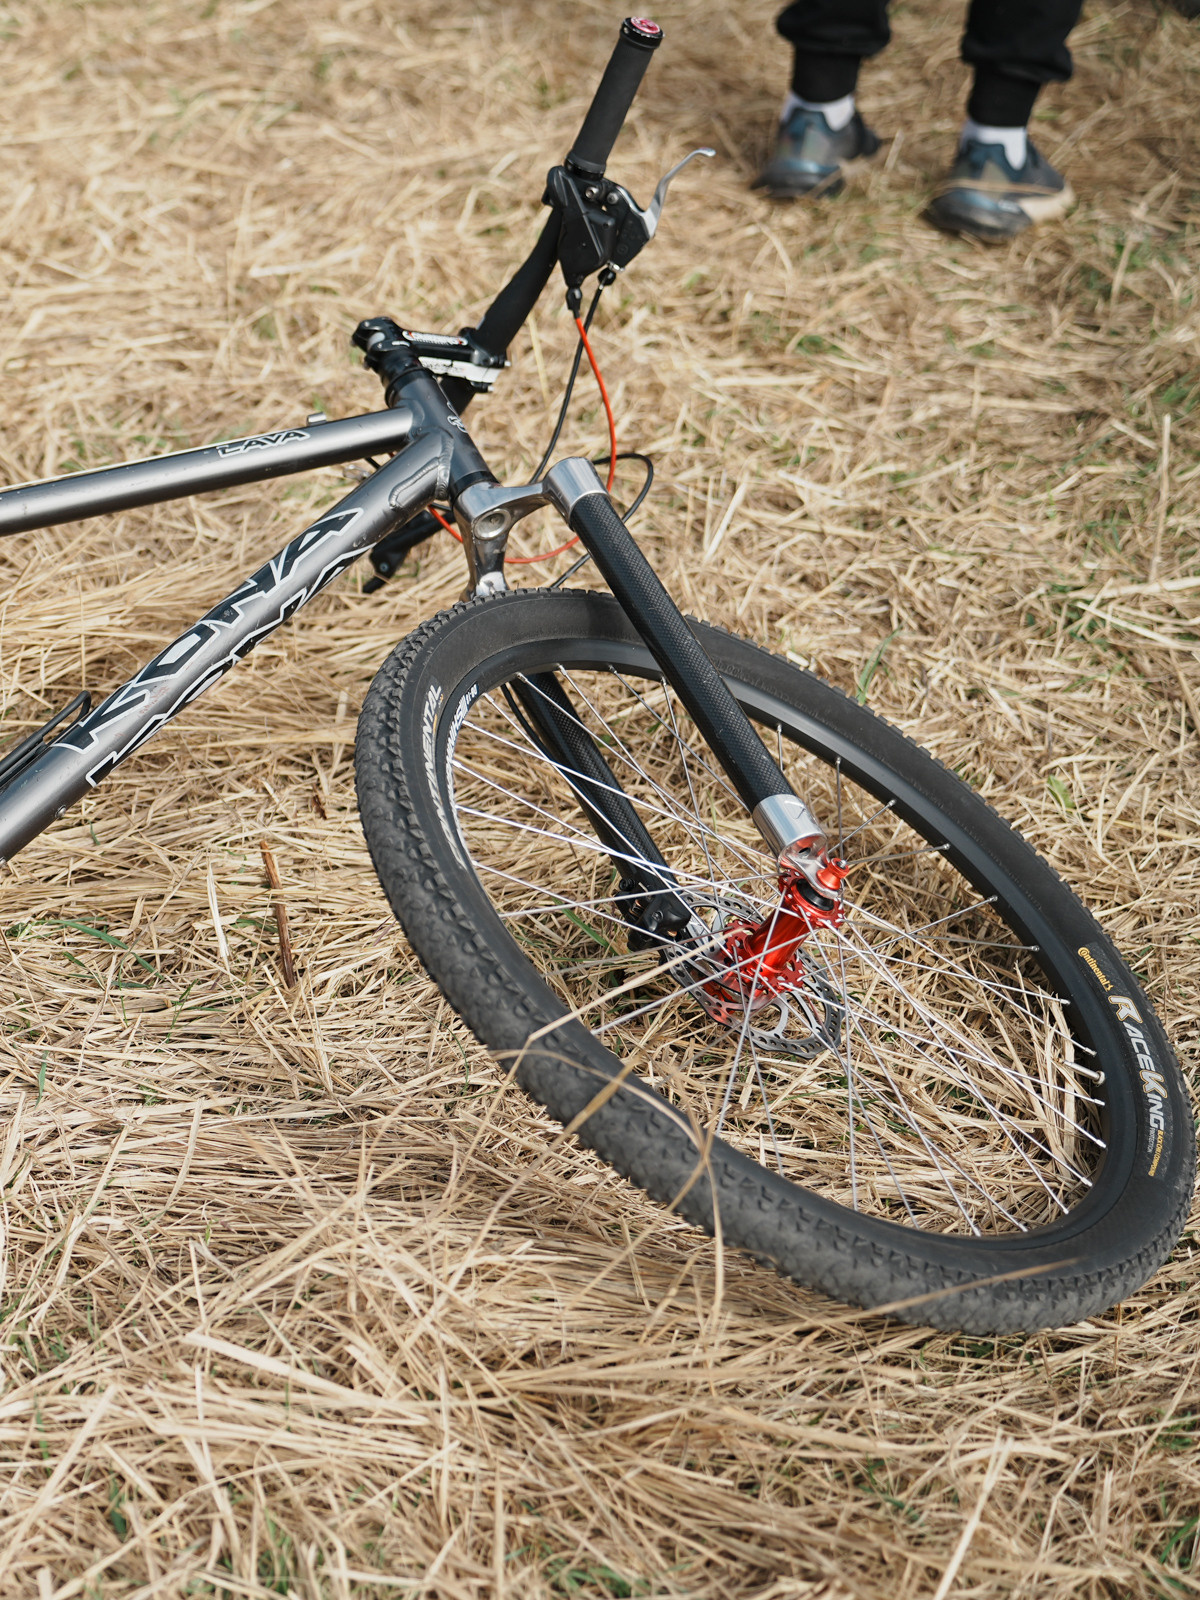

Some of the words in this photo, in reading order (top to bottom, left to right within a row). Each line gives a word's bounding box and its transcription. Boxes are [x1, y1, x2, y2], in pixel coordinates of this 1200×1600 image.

[216, 430, 311, 458] LAVA
[54, 507, 364, 755] KONA
[1077, 946, 1110, 986] Continental
